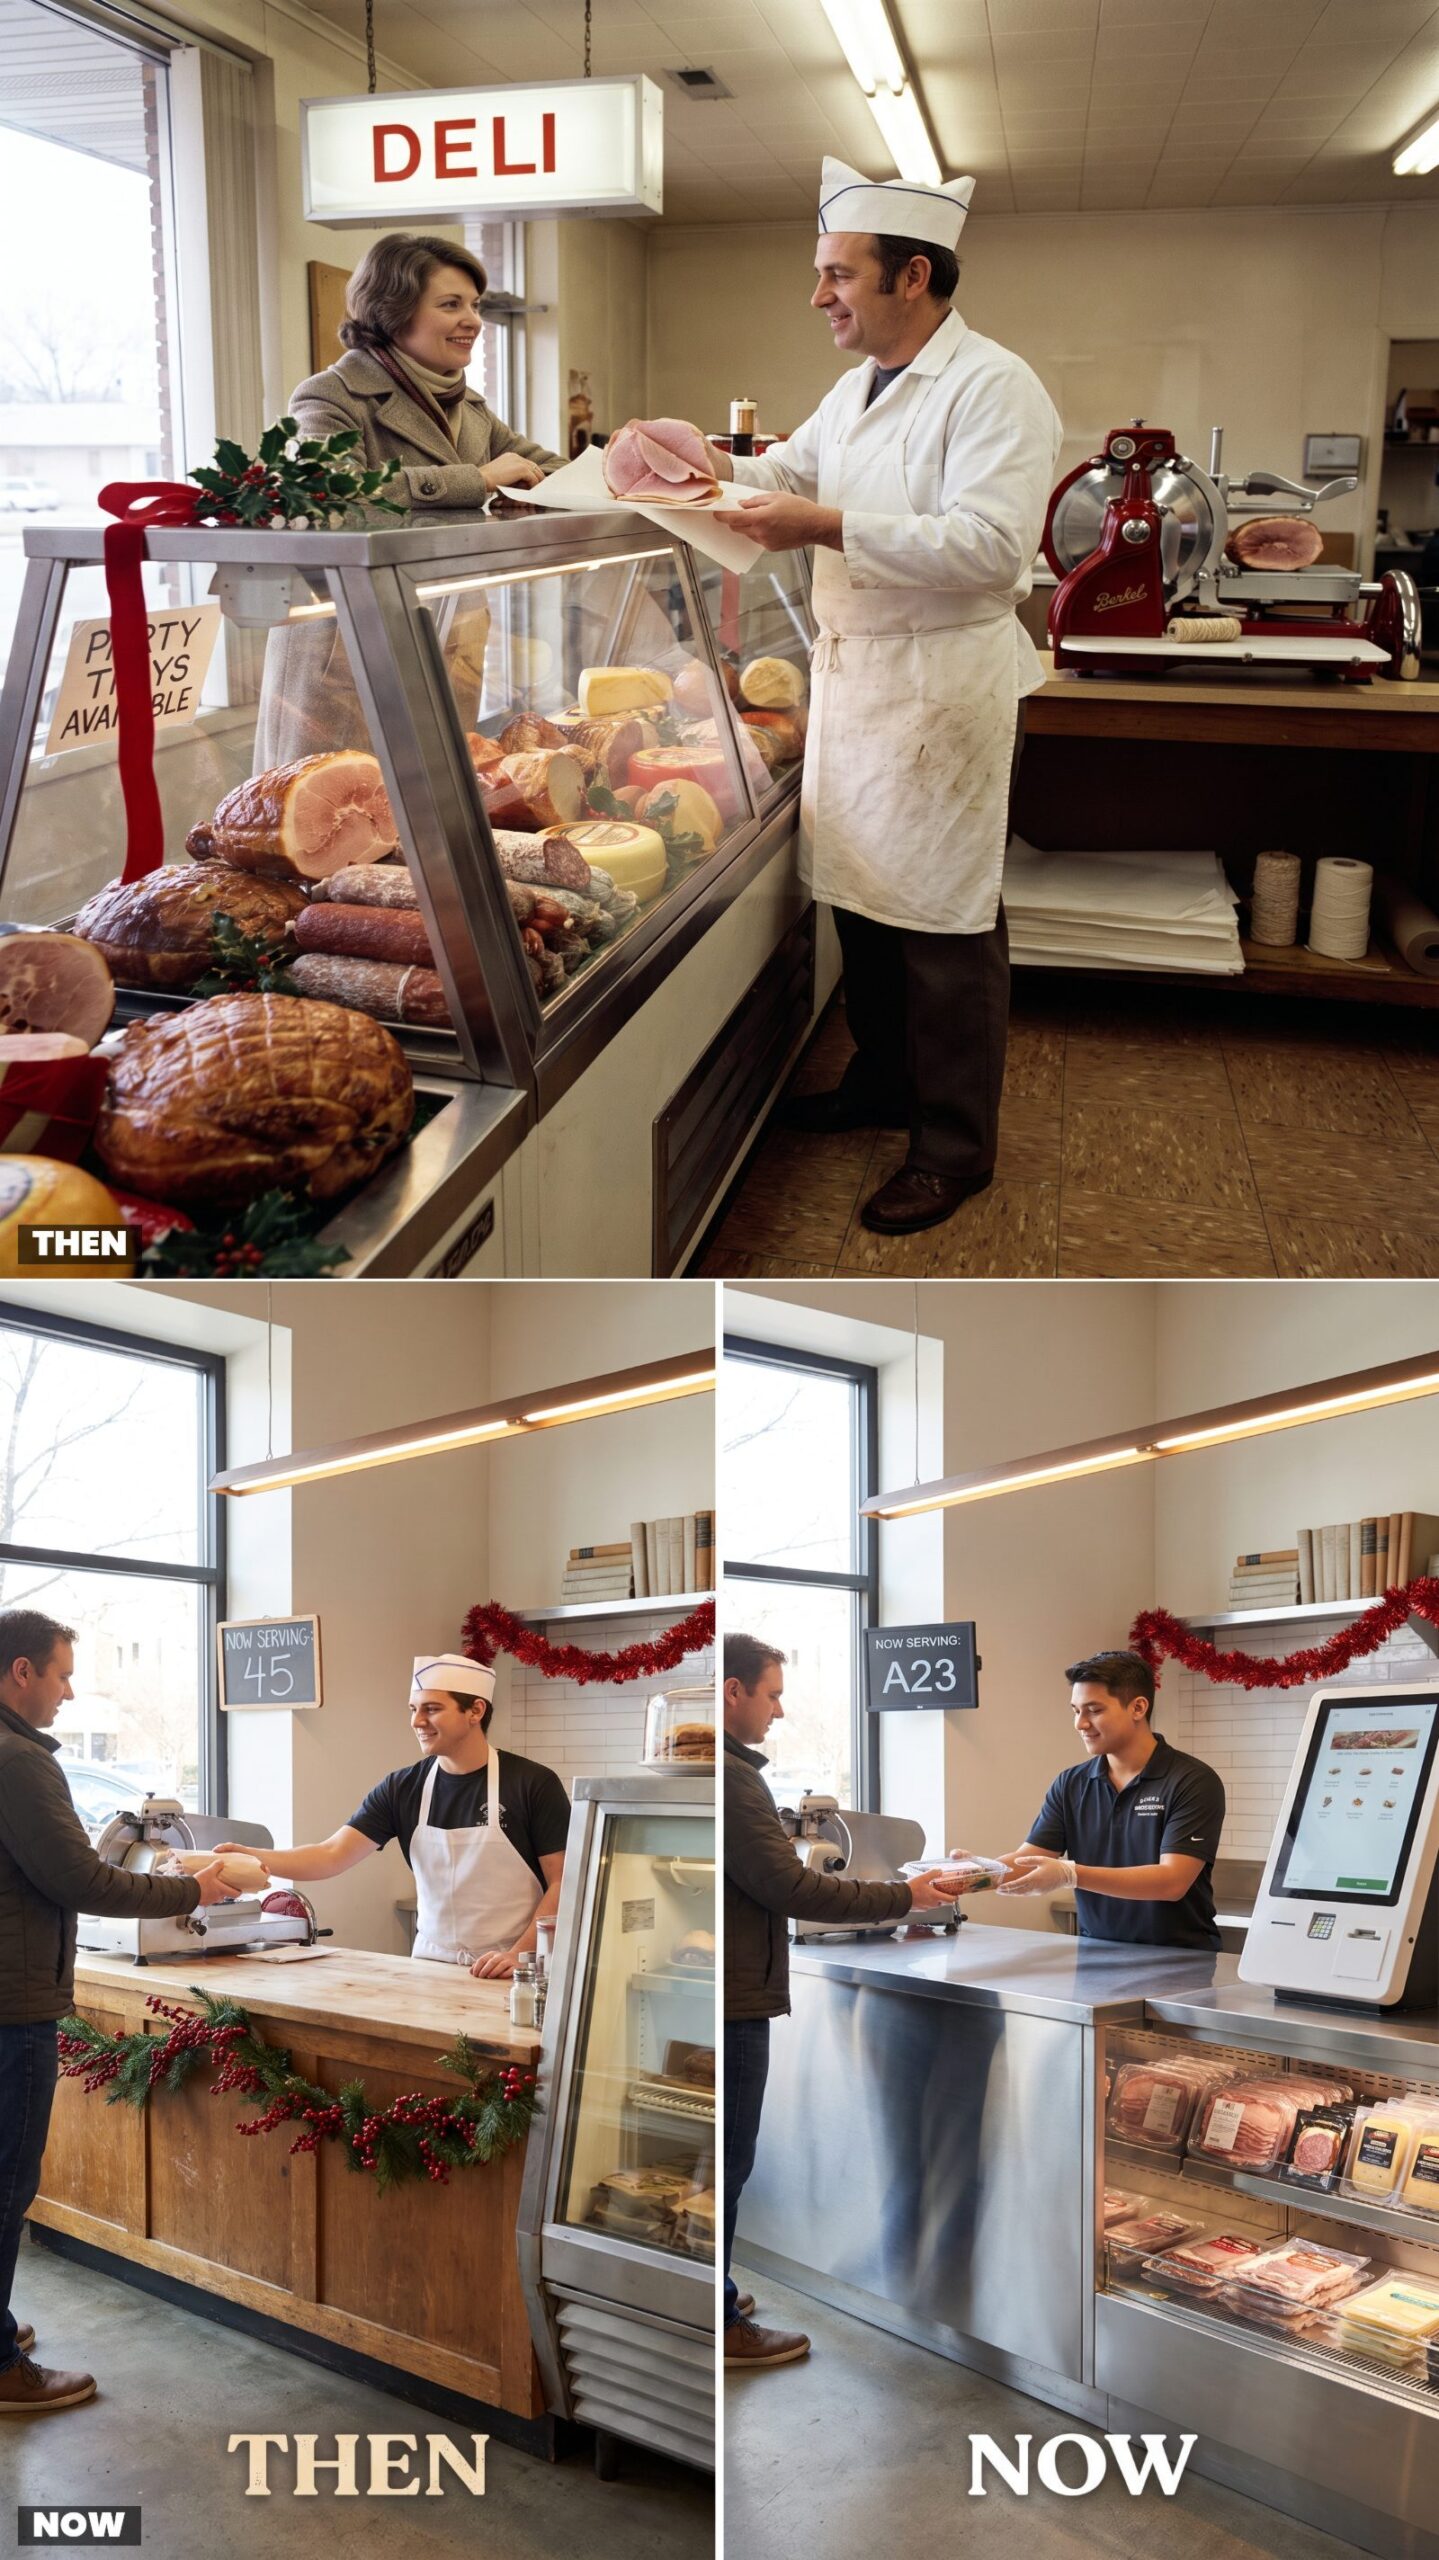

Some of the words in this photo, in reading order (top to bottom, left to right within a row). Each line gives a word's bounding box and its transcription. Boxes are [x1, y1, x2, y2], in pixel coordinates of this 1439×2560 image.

[373, 112, 556, 183] DELI
[1093, 583, 1148, 612] Berkel
[85, 617, 202, 664] PTY
[87, 654, 190, 699] TYS
[60, 686, 193, 740] AVAIBLE
[225, 1631, 253, 1651] NOW
[875, 1639, 904, 1649] NOW
[906, 1635, 961, 1648] SERVING:
[243, 1653, 294, 1698] 45
[882, 1658, 957, 1694] A23
